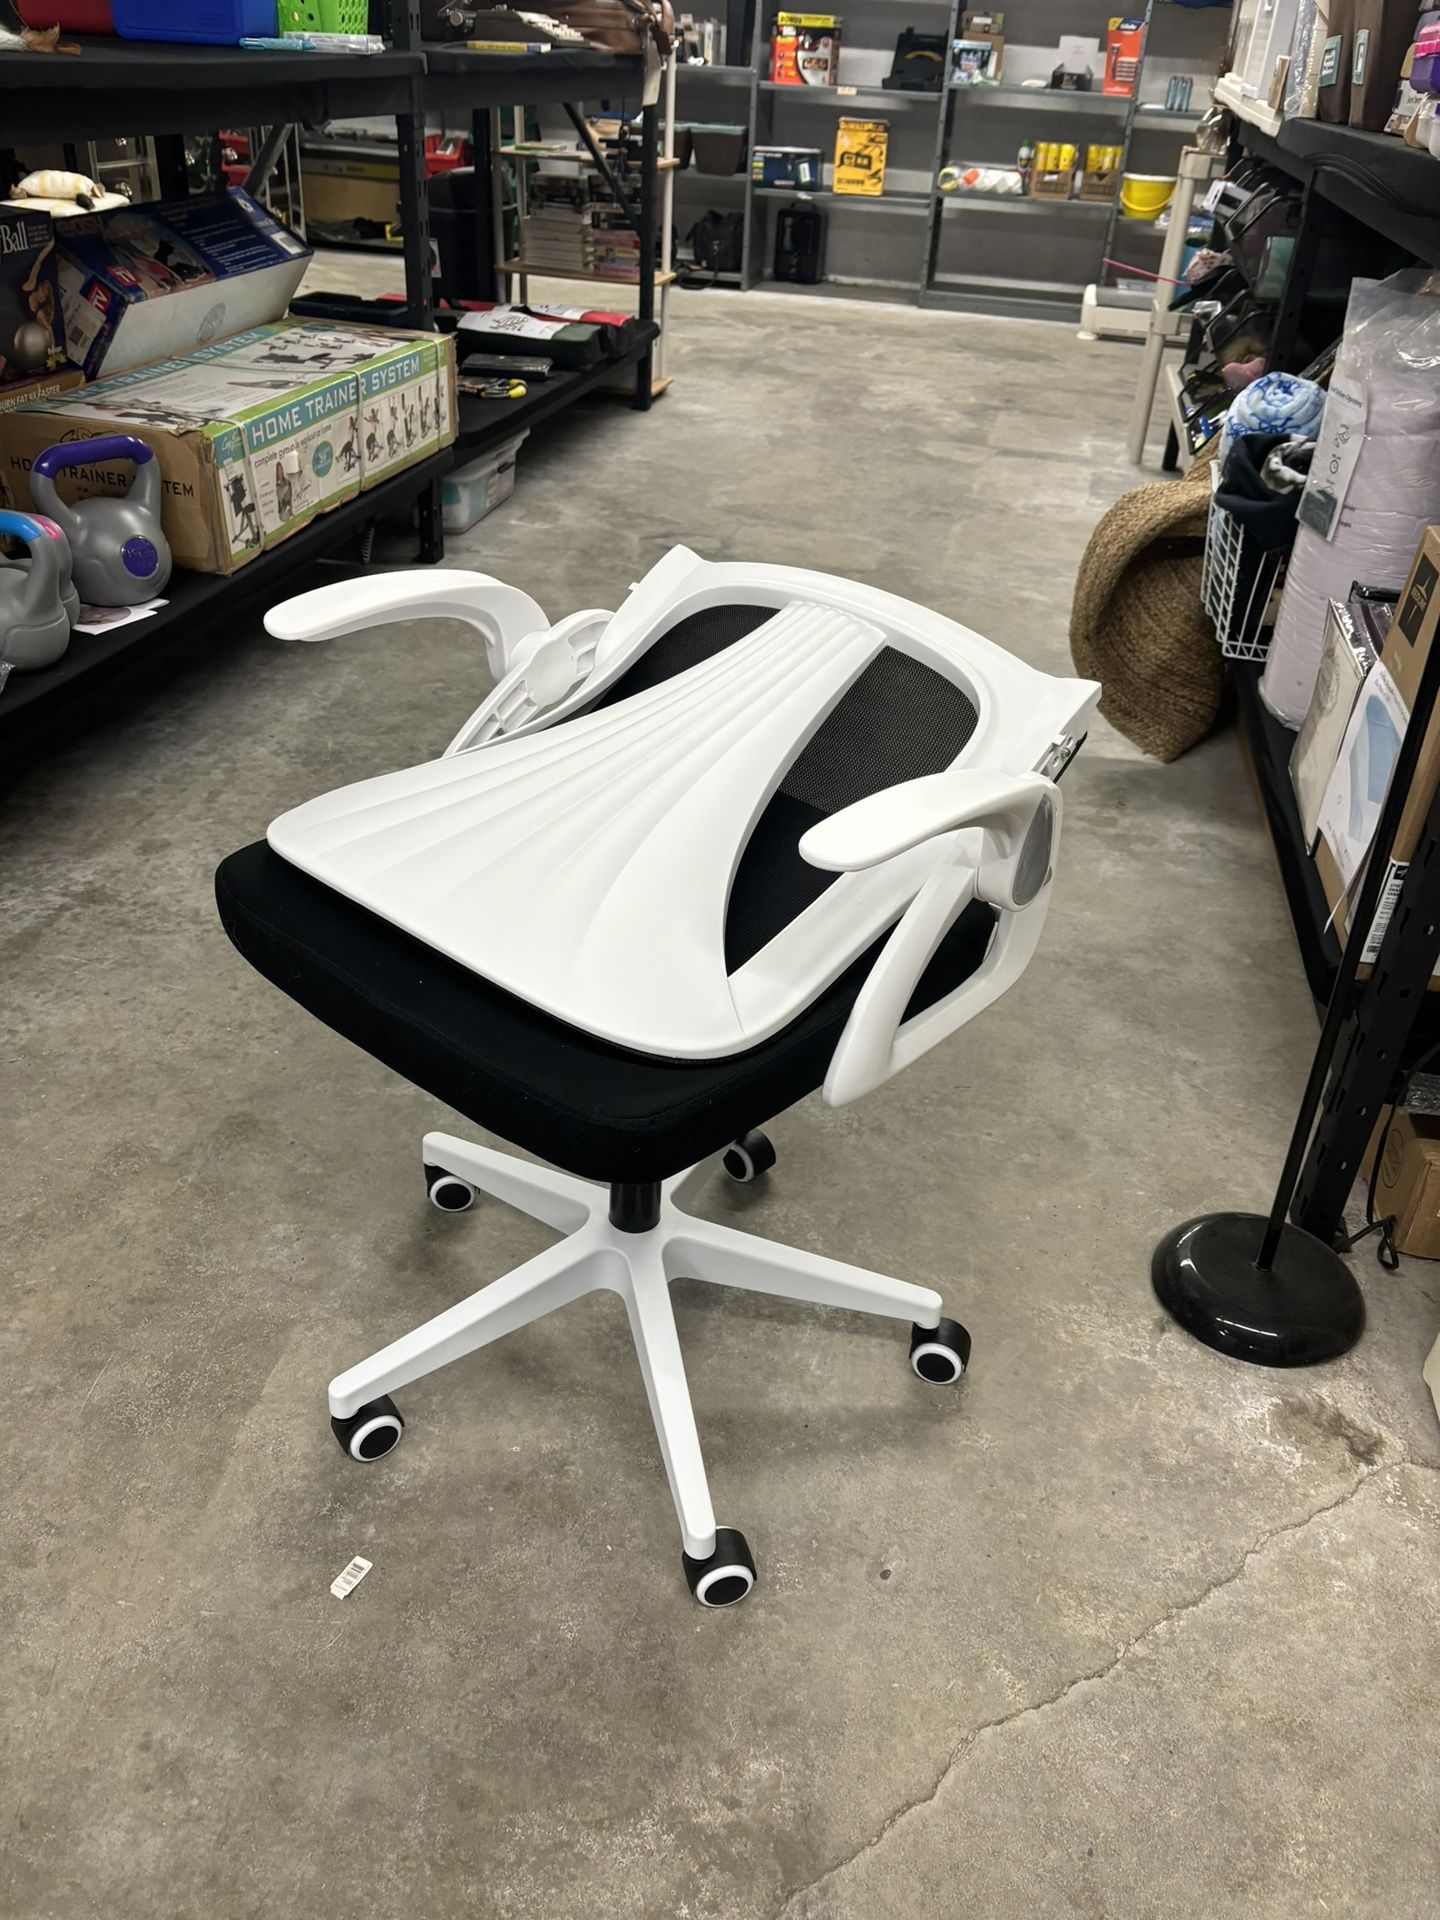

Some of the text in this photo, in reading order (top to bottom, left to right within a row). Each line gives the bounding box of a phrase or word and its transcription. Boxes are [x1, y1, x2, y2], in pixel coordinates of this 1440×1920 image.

[251, 406, 303, 446] HOME
[305, 378, 367, 421] TRAINER
[371, 355, 421, 391] SYSTEM
[61, 466, 127, 487] TRAINER
